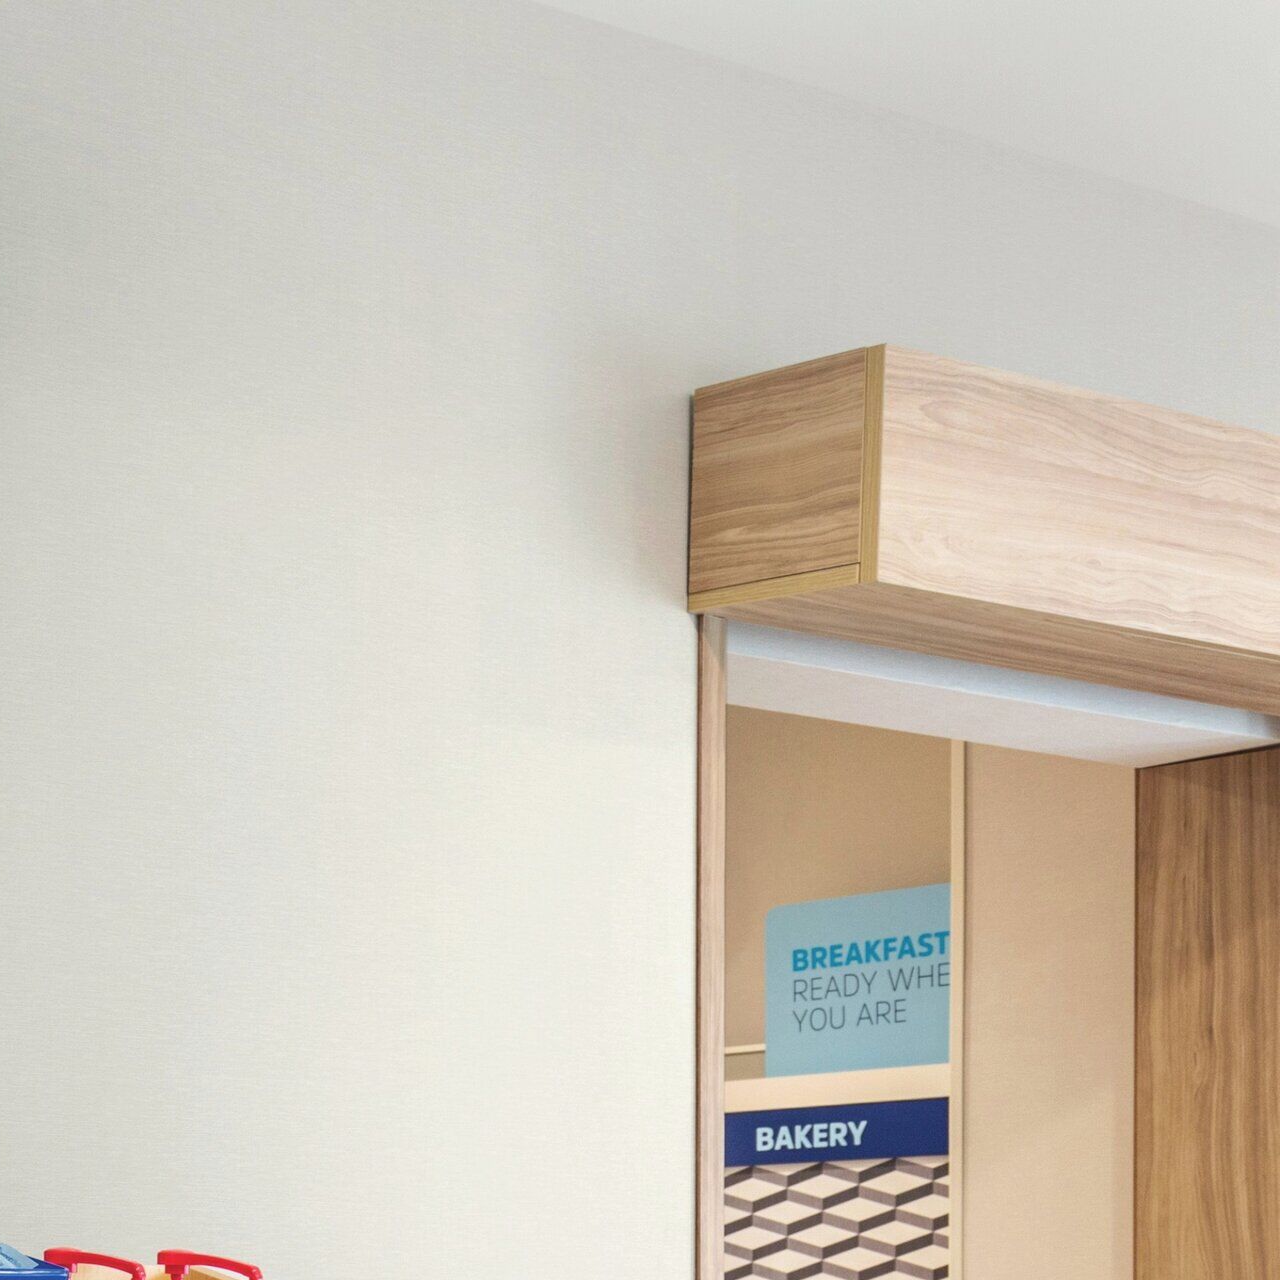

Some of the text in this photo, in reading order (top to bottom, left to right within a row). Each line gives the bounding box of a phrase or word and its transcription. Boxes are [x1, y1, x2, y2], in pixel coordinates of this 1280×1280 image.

[792, 930, 950, 972] BREAKFAST
[793, 962, 950, 1002] READY WHE
[792, 998, 907, 1033] YOU ARE
[755, 1120, 867, 1151] BAKERY
